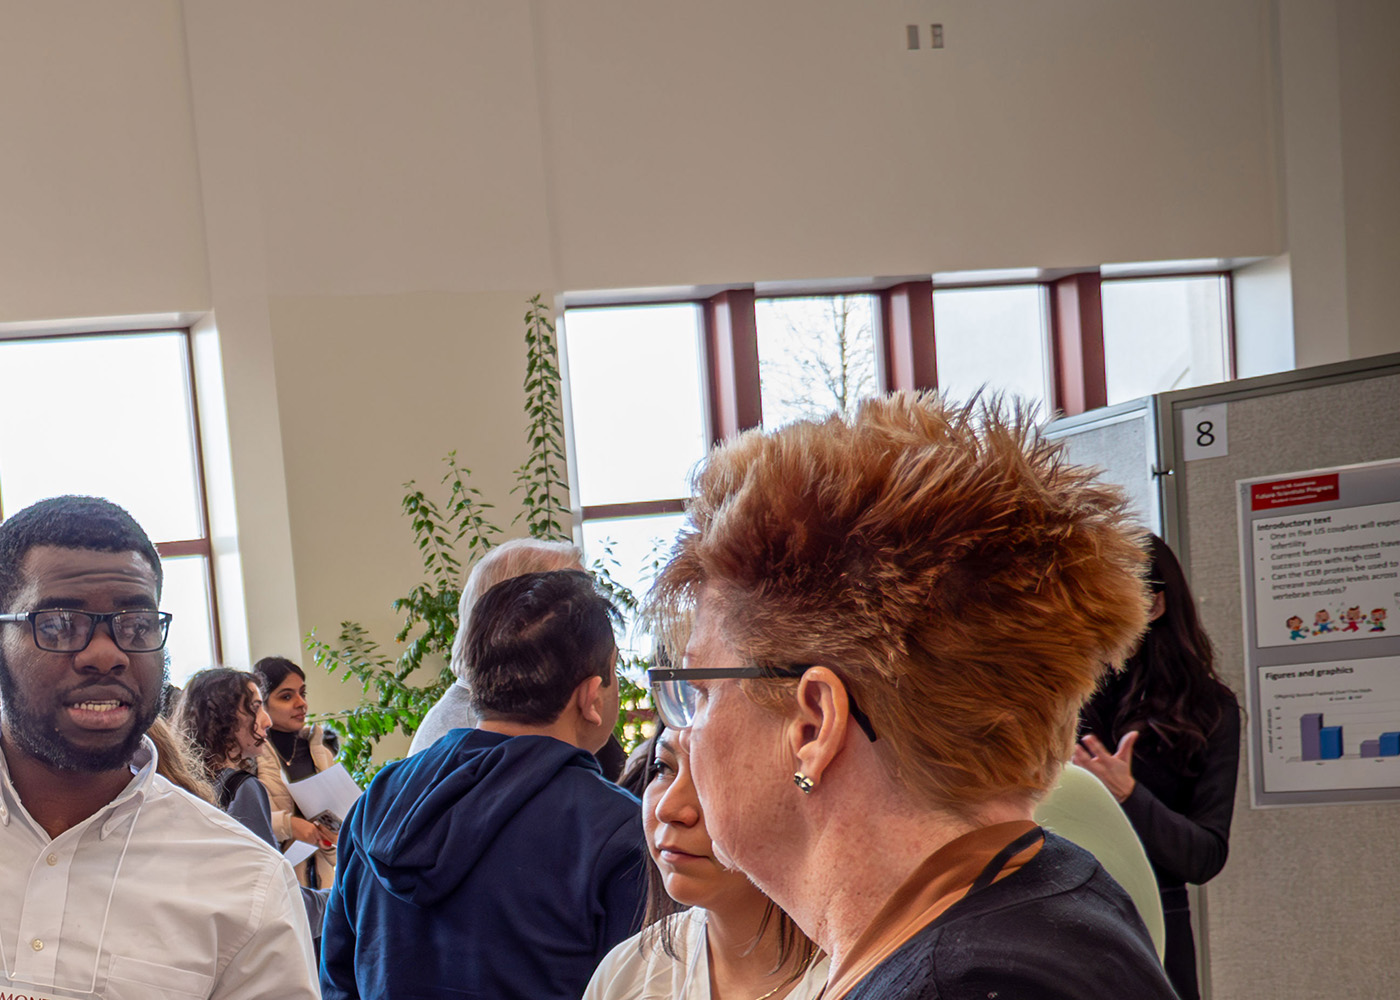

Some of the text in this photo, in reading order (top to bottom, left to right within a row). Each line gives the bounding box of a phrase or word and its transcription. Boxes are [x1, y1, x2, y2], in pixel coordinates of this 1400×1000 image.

[1197, 421, 1215, 447] 8
[1257, 516, 1331, 531] Introductory text
[1327, 524, 1358, 533] couples
[1271, 552, 1301, 560] Current
[1368, 561, 1387, 570] used
[1265, 667, 1354, 680] Figures and graphics
